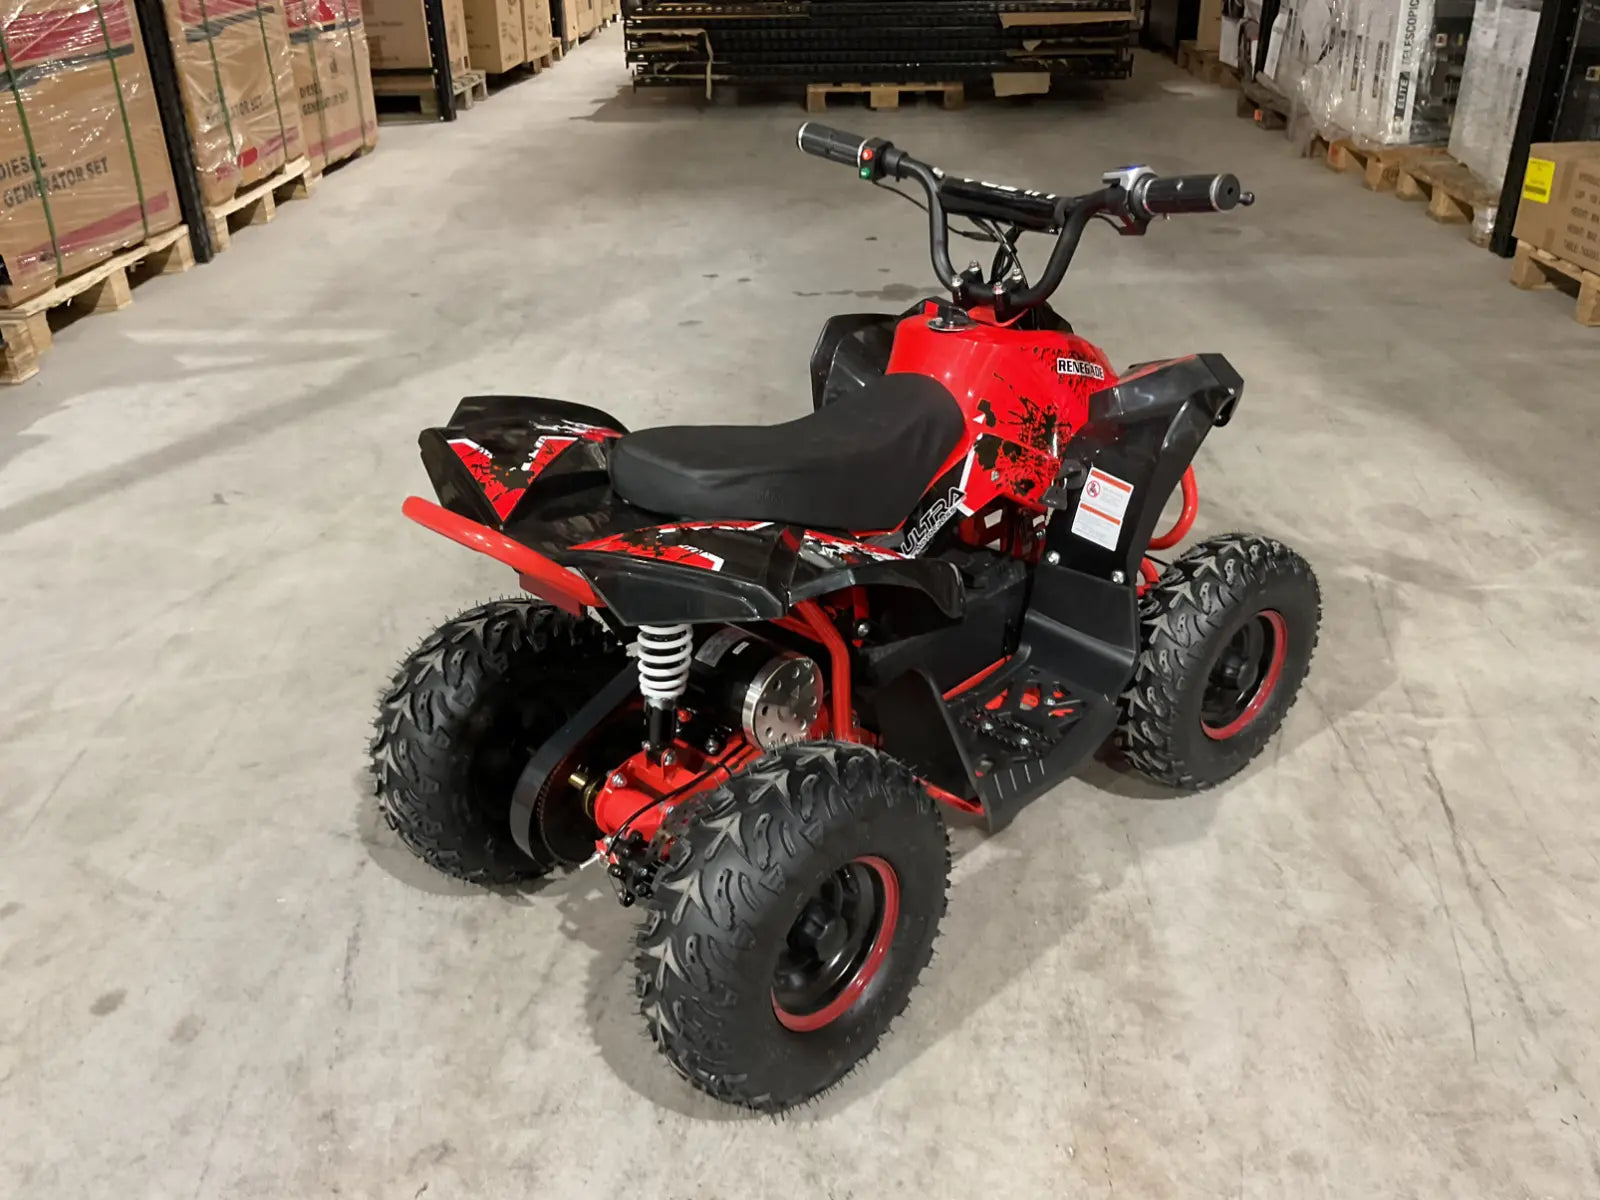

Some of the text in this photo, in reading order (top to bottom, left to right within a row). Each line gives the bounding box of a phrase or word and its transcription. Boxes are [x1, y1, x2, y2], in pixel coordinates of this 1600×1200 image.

[1397, 78, 1409, 110] ELITE
[0, 156, 47, 181] DIESL
[86, 157, 109, 180] SET
[1058, 359, 1104, 379] RENEGADE
[900, 486, 966, 556] ULTRA
